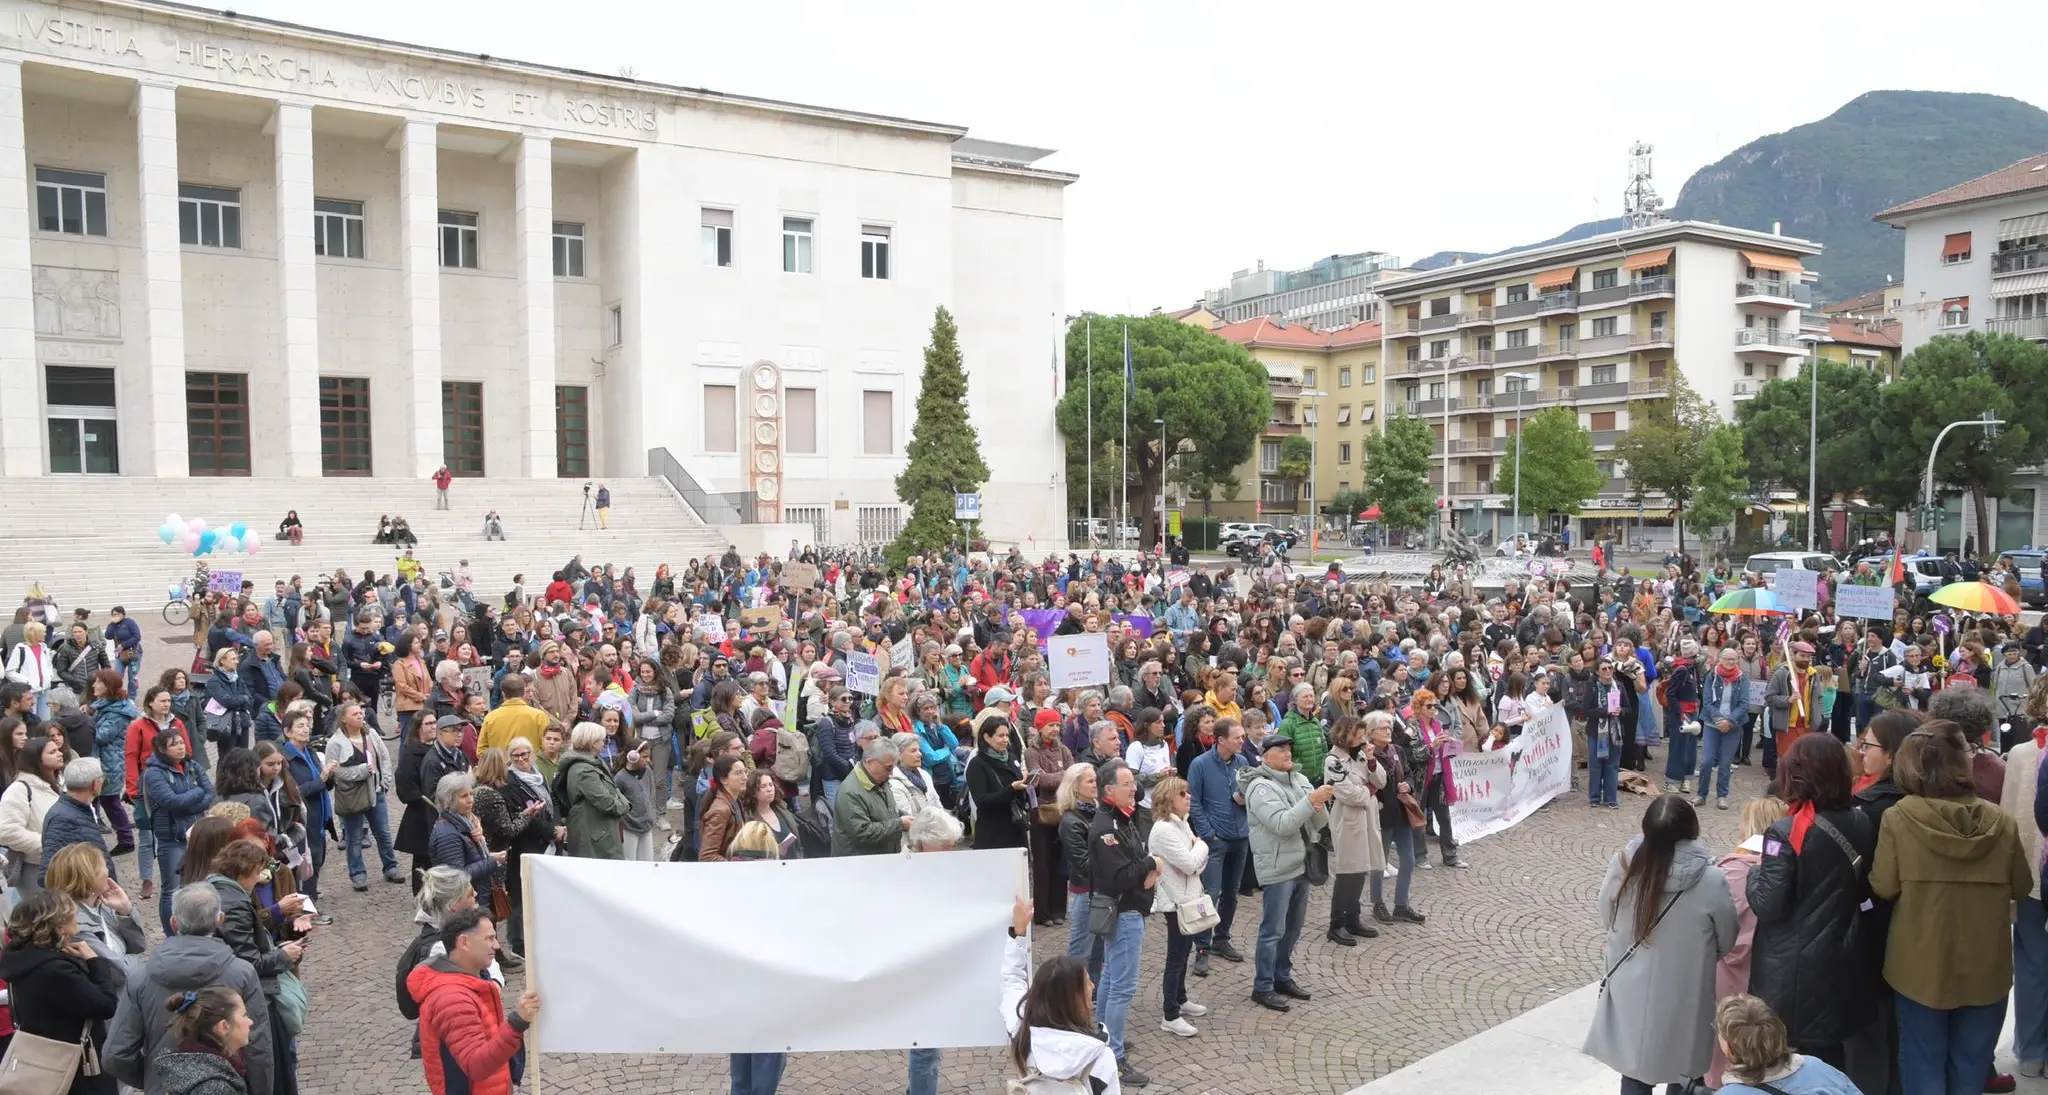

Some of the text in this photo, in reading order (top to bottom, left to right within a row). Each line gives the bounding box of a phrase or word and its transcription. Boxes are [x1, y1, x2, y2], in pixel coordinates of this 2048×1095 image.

[15, 11, 143, 58] IVSTITIA
[175, 39, 338, 88] HIERARCHIA
[511, 92, 538, 116] ET
[563, 99, 658, 132] ROSTRIS
[958, 497, 964, 508] P
[968, 497, 976, 508] P
